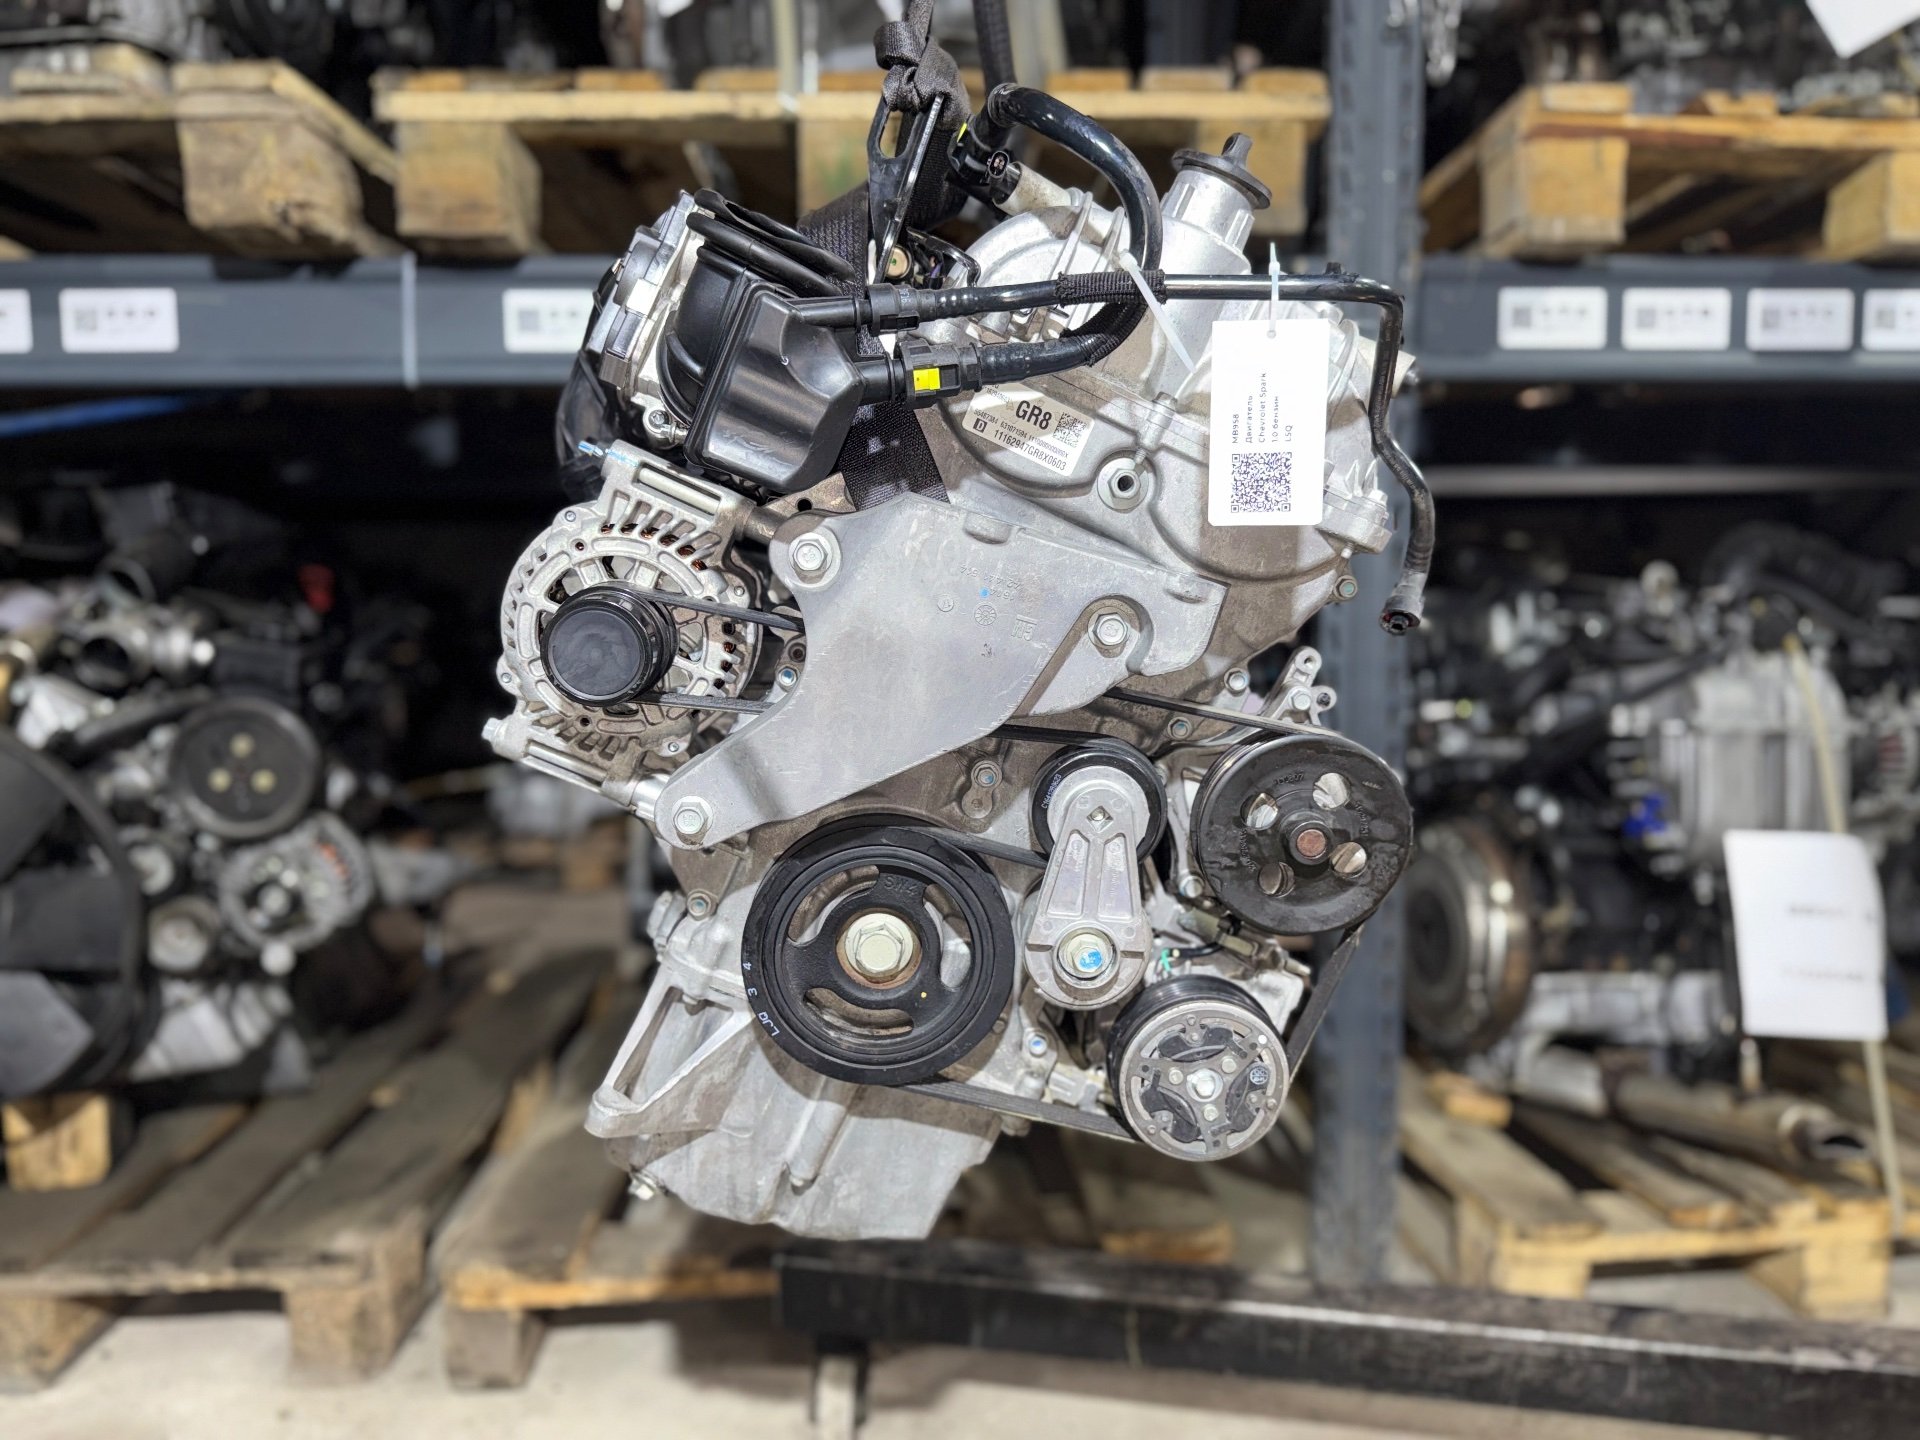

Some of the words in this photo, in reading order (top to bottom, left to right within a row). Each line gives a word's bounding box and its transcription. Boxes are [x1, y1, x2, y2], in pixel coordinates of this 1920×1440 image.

[1259, 372, 1267, 398] Spark
[974, 418, 987, 433] D
[1015, 400, 1052, 430] GR8
[1245, 395, 1253, 443] Двигатель
[1258, 401, 1266, 443] Chevrolet
[1271, 395, 1279, 430] бензин
[743, 961, 752, 971] 4
[747, 987, 758, 997] 3
